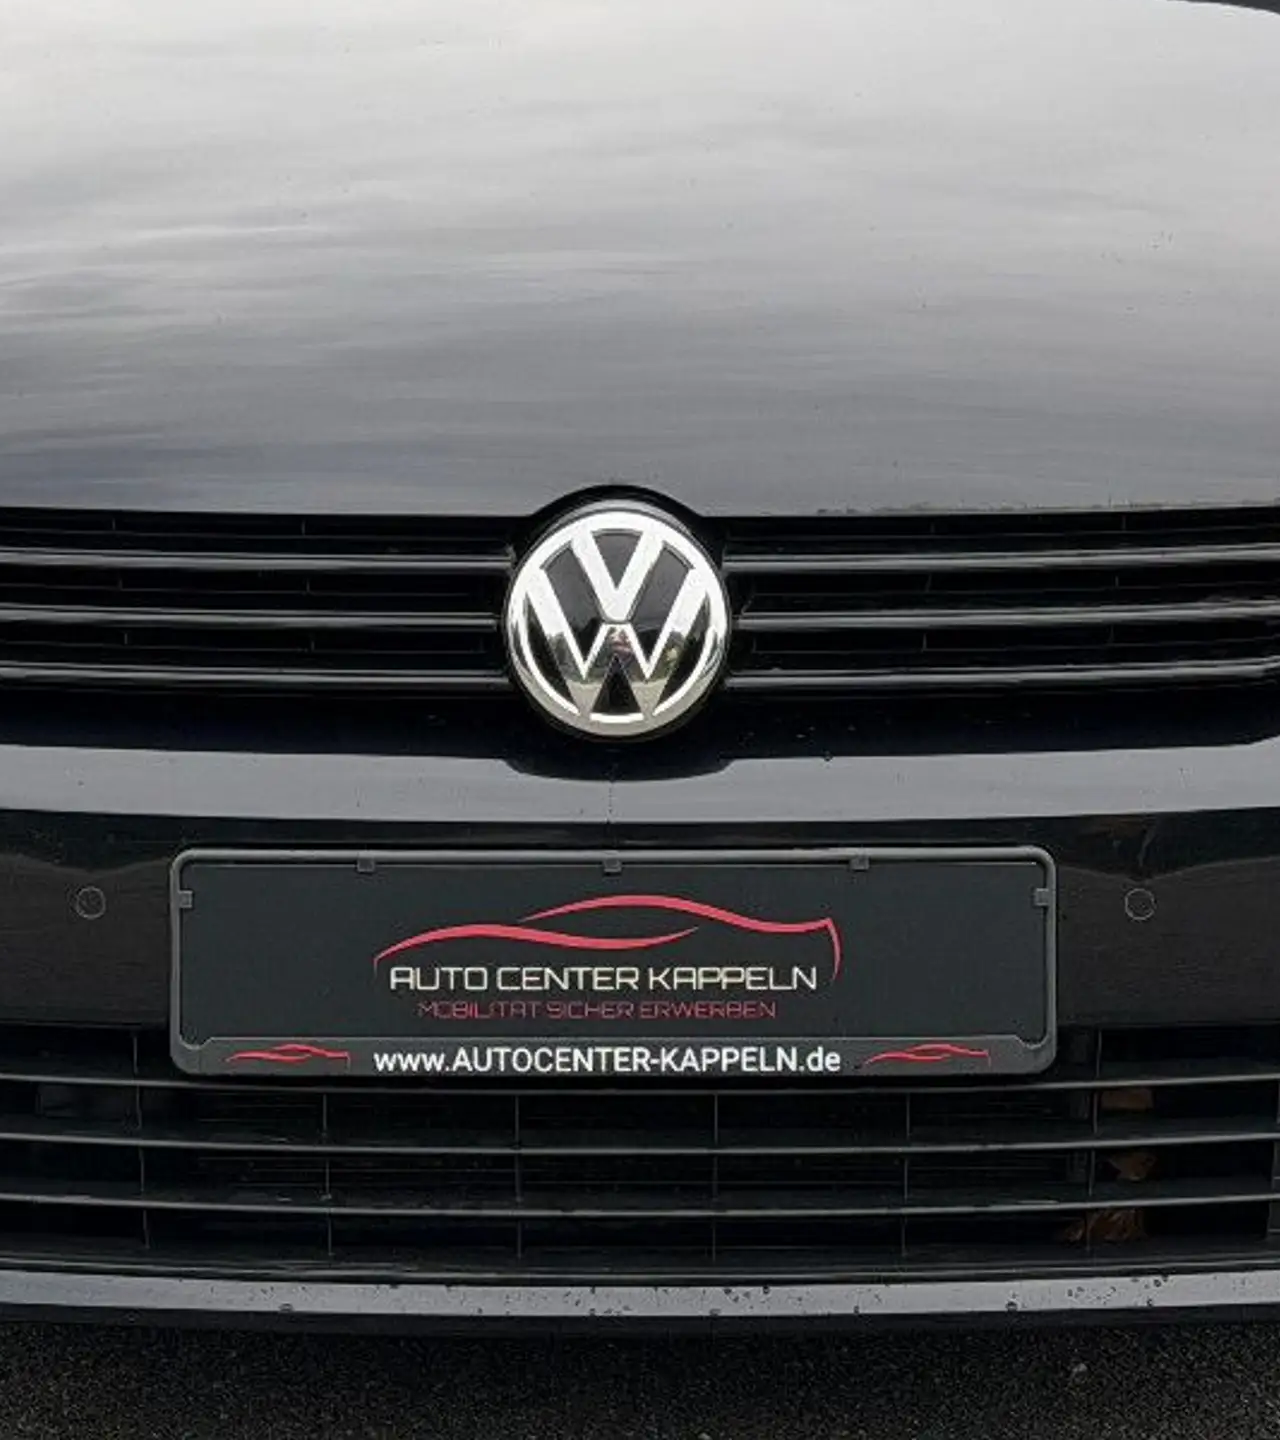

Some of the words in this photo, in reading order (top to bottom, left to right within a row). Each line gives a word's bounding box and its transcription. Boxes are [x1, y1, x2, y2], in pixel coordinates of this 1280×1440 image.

[506, 499, 729, 736] VW
[389, 966, 489, 991] AUTO
[496, 966, 639, 991] CENTER
[648, 965, 818, 991] KAPPELN
[546, 1000, 634, 1019] SICHER
[639, 1000, 777, 1020] ERWERBEN
[372, 1045, 842, 1073] www.AUTOCENTER-KAPPELN.de
